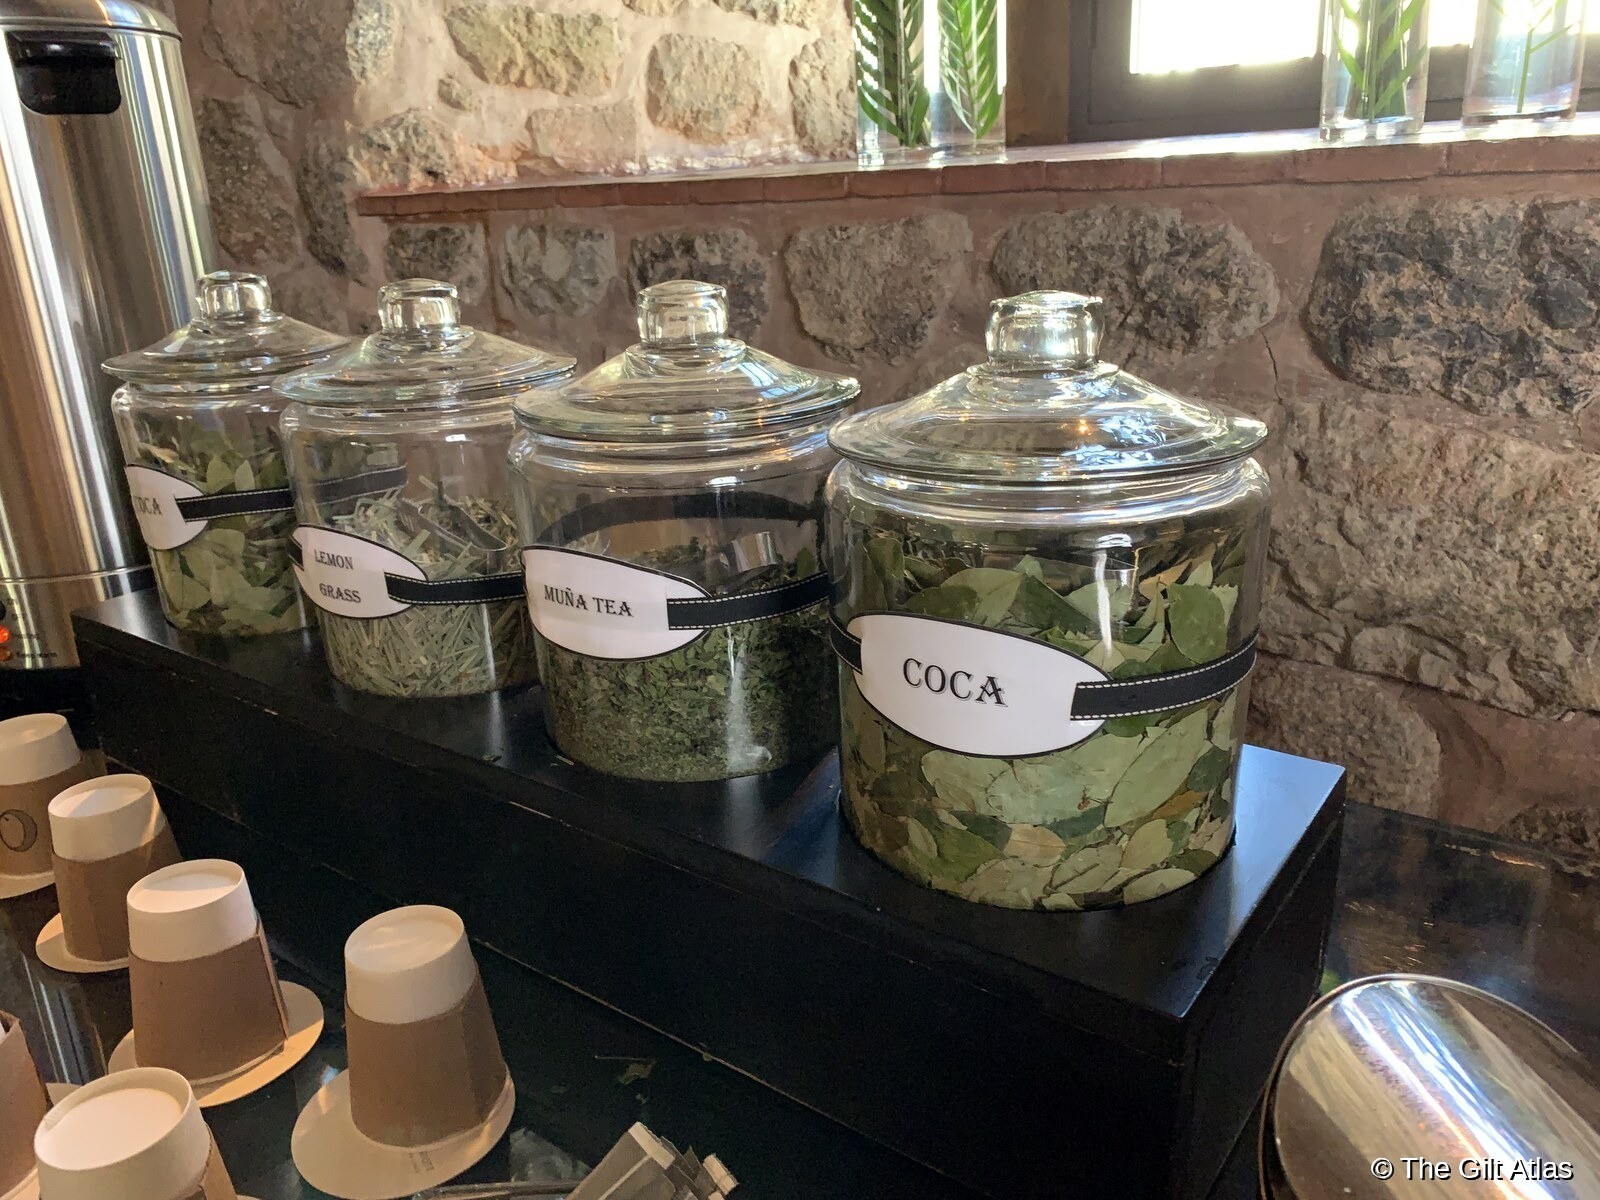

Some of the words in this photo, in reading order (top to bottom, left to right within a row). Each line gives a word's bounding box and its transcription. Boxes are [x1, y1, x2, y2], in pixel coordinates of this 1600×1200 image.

[313, 549, 354, 570] LEMON
[319, 582, 362, 603] GRASS
[544, 584, 589, 611] MUÑA
[592, 597, 634, 617] TEA
[903, 657, 1008, 707] COCA
